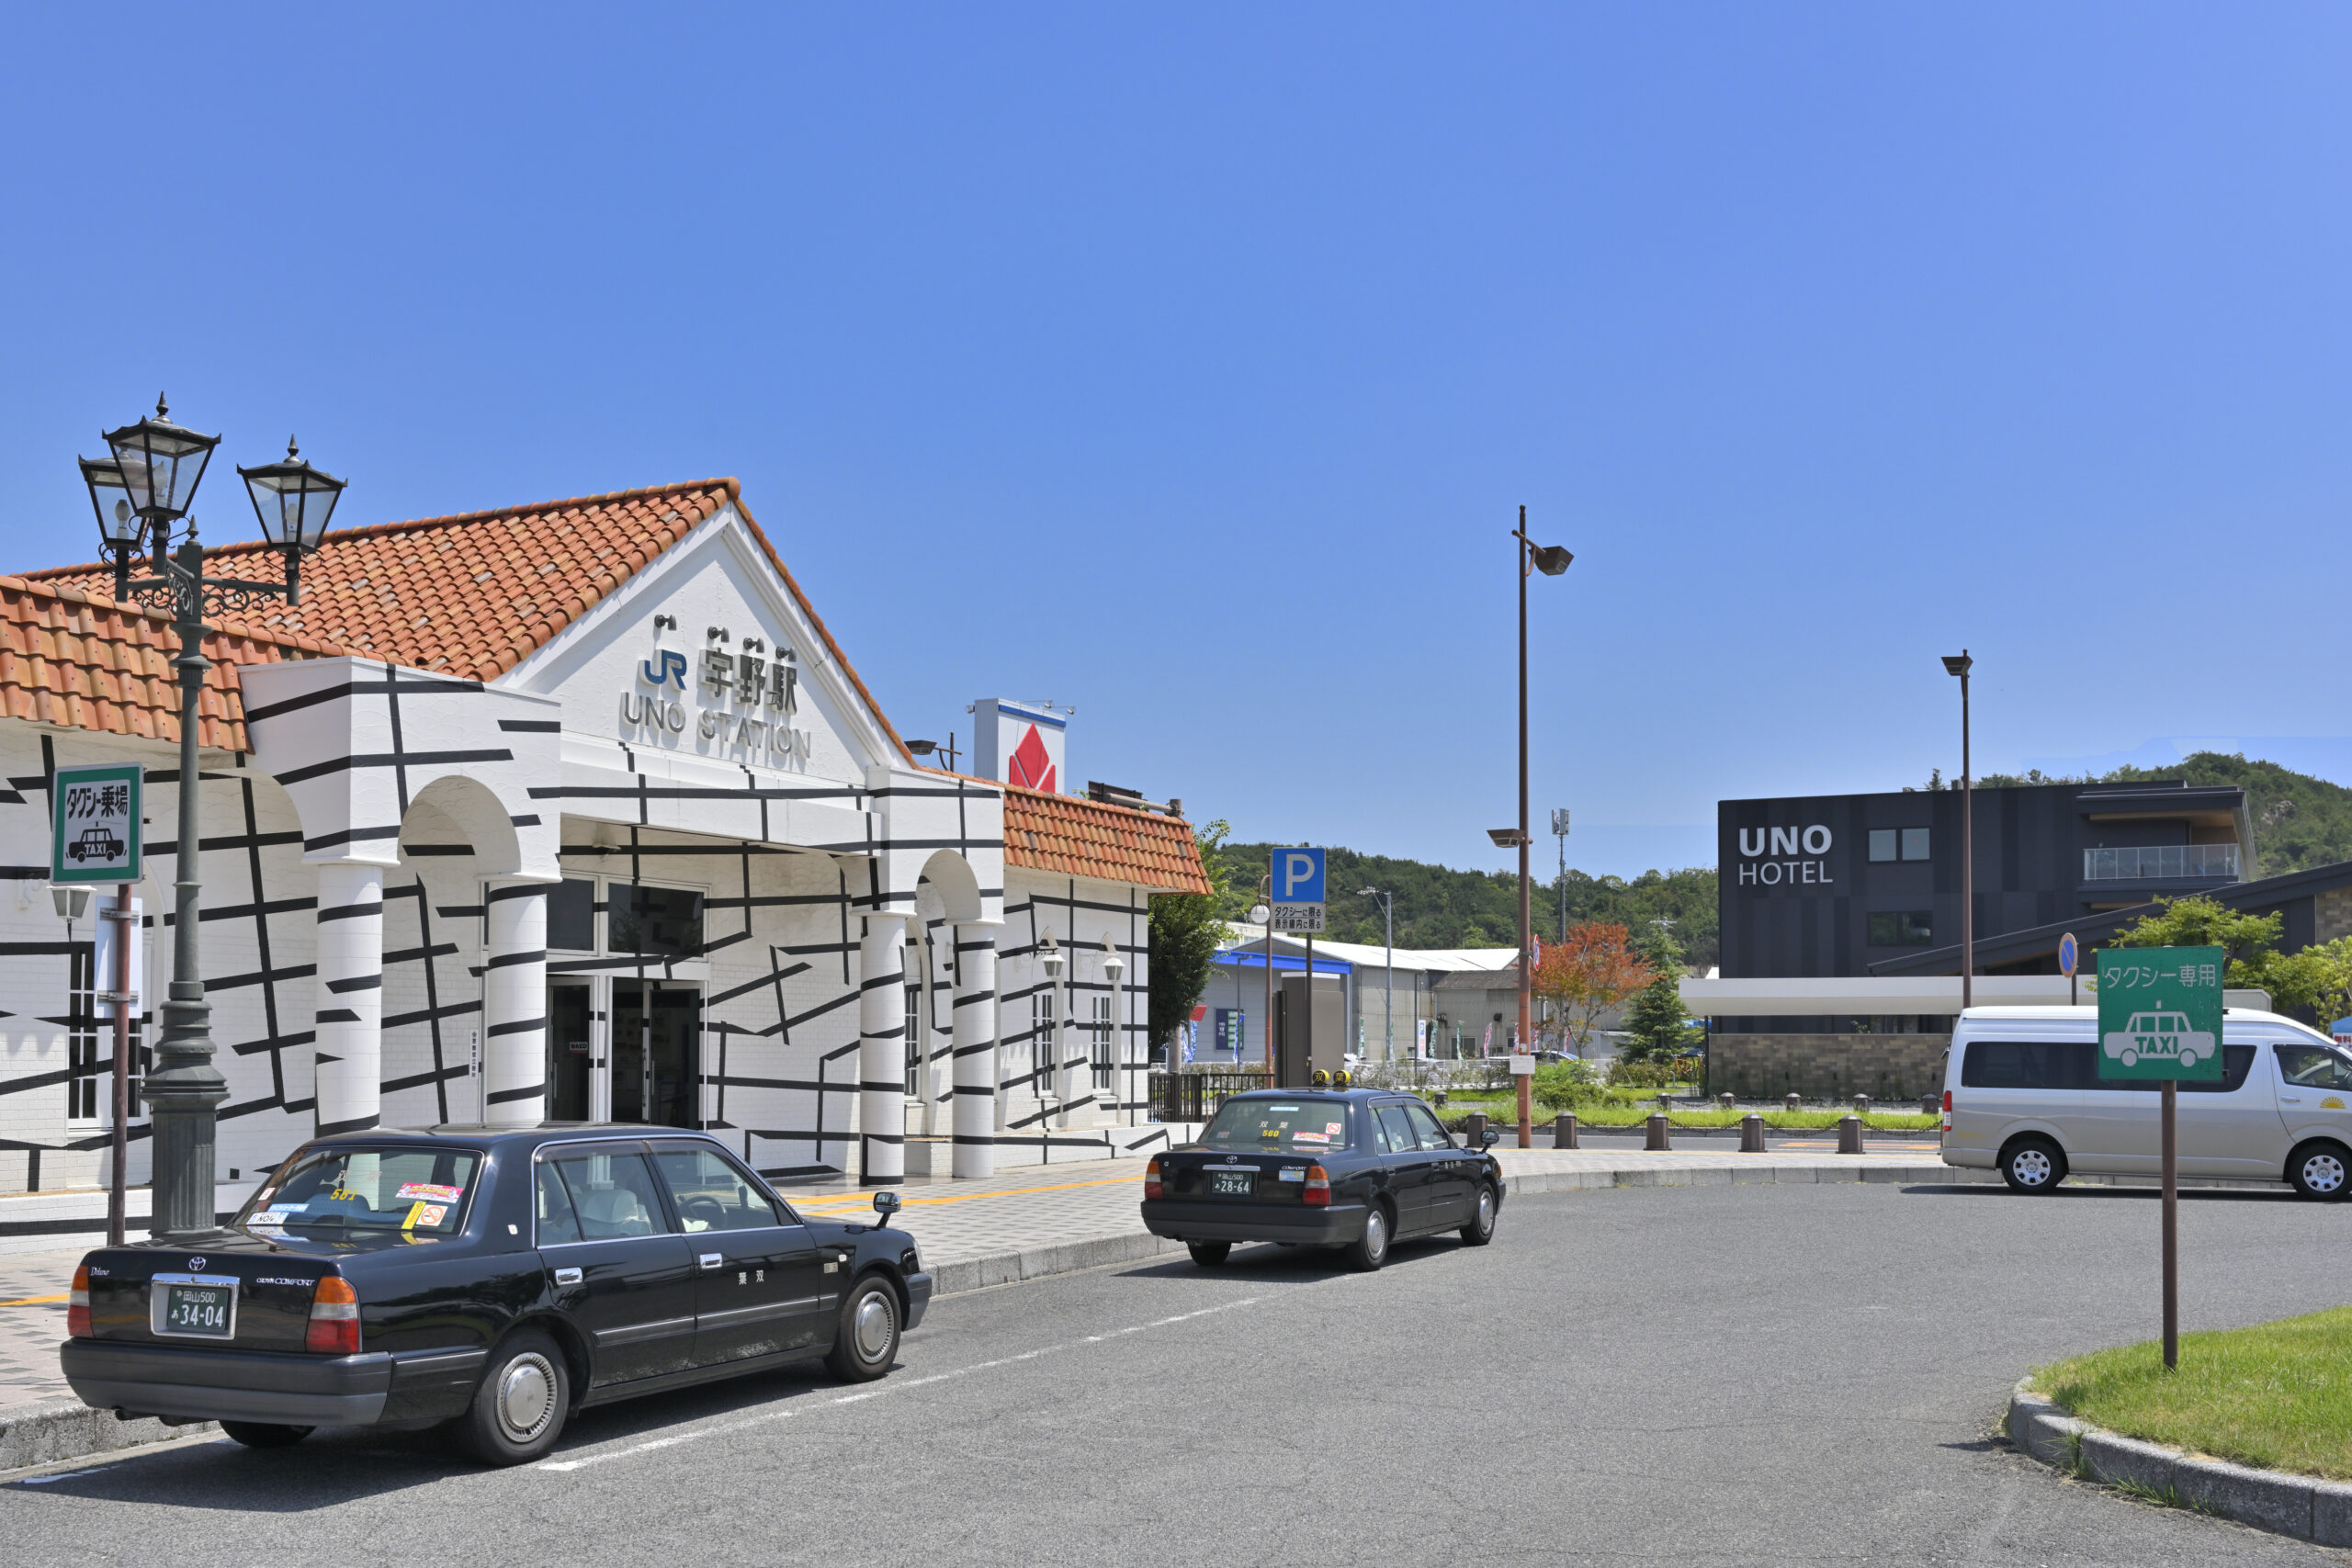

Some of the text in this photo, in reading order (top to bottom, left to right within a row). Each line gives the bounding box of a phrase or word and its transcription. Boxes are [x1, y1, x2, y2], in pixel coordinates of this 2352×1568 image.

[645, 649, 687, 690] JR
[704, 648, 797, 715] 宇野駅
[622, 692, 811, 759] UNO STATION
[67, 784, 128, 819] タクシー乗場
[85, 843, 107, 855] TAXI
[1739, 824, 1832, 856] UNO
[1286, 853, 1316, 897] P
[1739, 861, 1833, 886] HOTEL
[1274, 906, 1321, 917] タクシーに限る
[1274, 919, 1321, 930] 表示線内に限る
[2104, 964, 2216, 989] タクシー専用
[2134, 1035, 2178, 1055] TAXI
[1261, 1130, 1279, 1138] 560
[330, 1188, 358, 1201] 561
[1220, 1180, 1250, 1193] 28-64
[275, 1277, 315, 1286] COMFORT
[171, 1304, 224, 1327] あ 34-04
